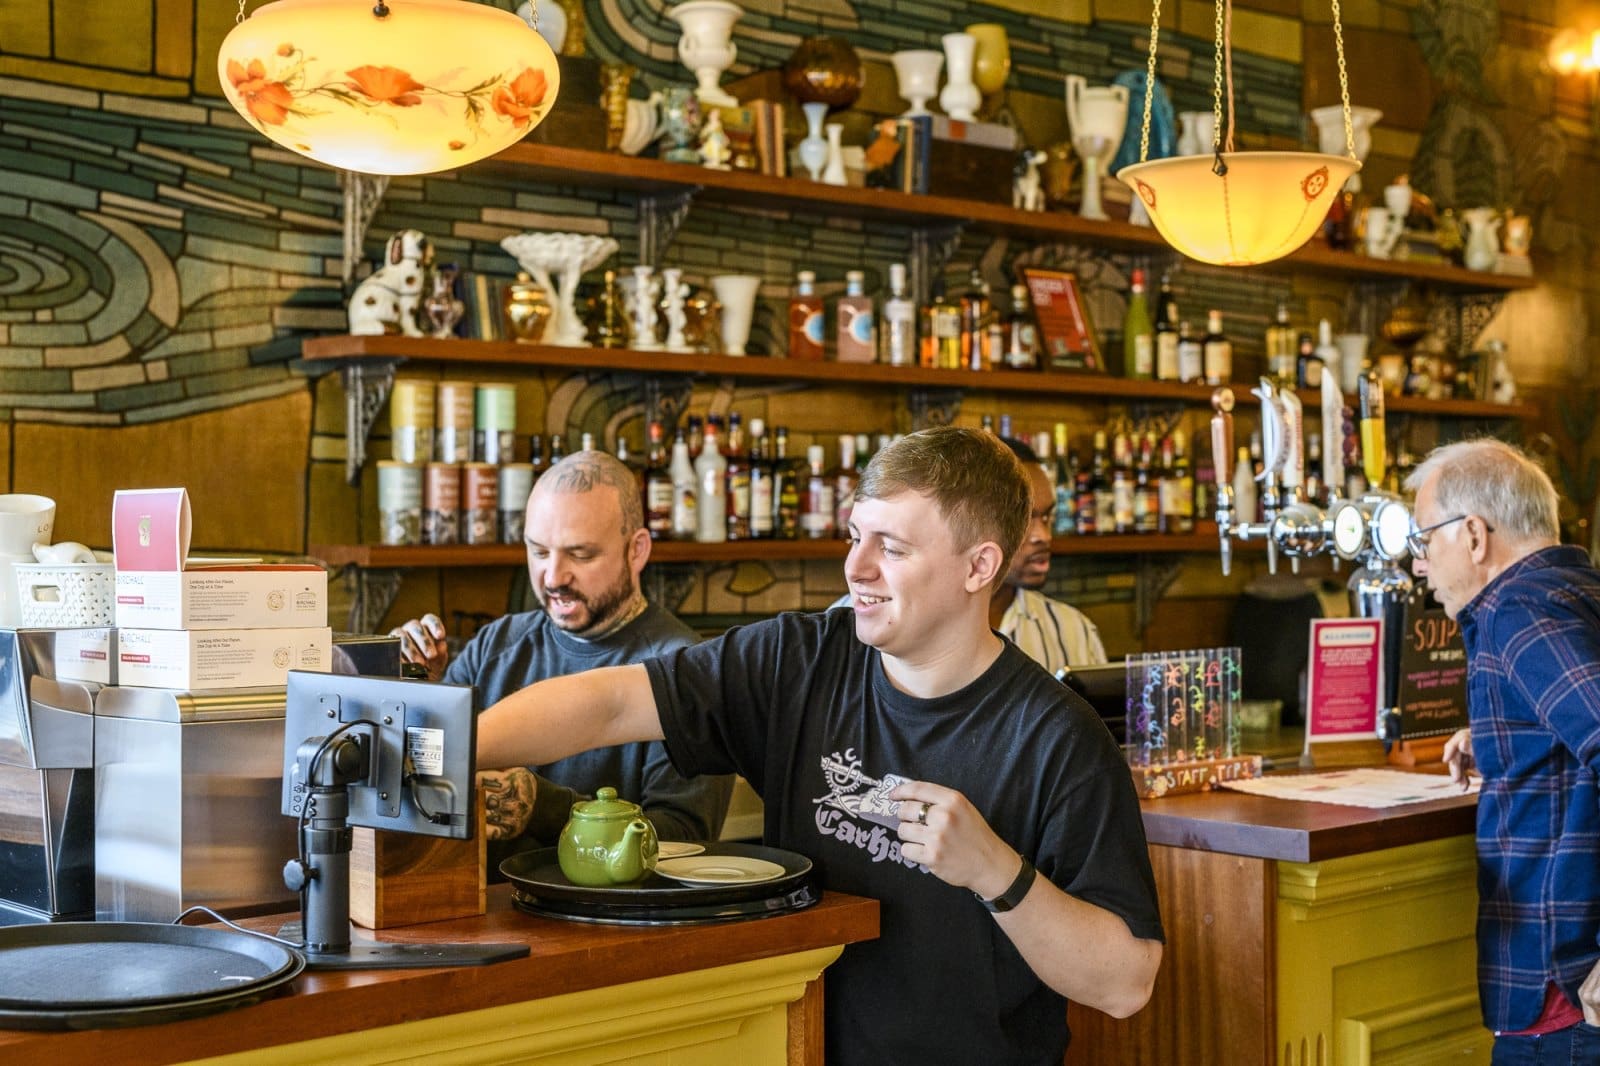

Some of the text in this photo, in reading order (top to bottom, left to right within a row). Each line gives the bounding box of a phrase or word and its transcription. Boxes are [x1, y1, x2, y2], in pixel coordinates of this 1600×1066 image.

[117, 575, 145, 585] BIRCHALL
[120, 632, 152, 643] BIRCHALL
[1166, 767, 1208, 788] STAFF
